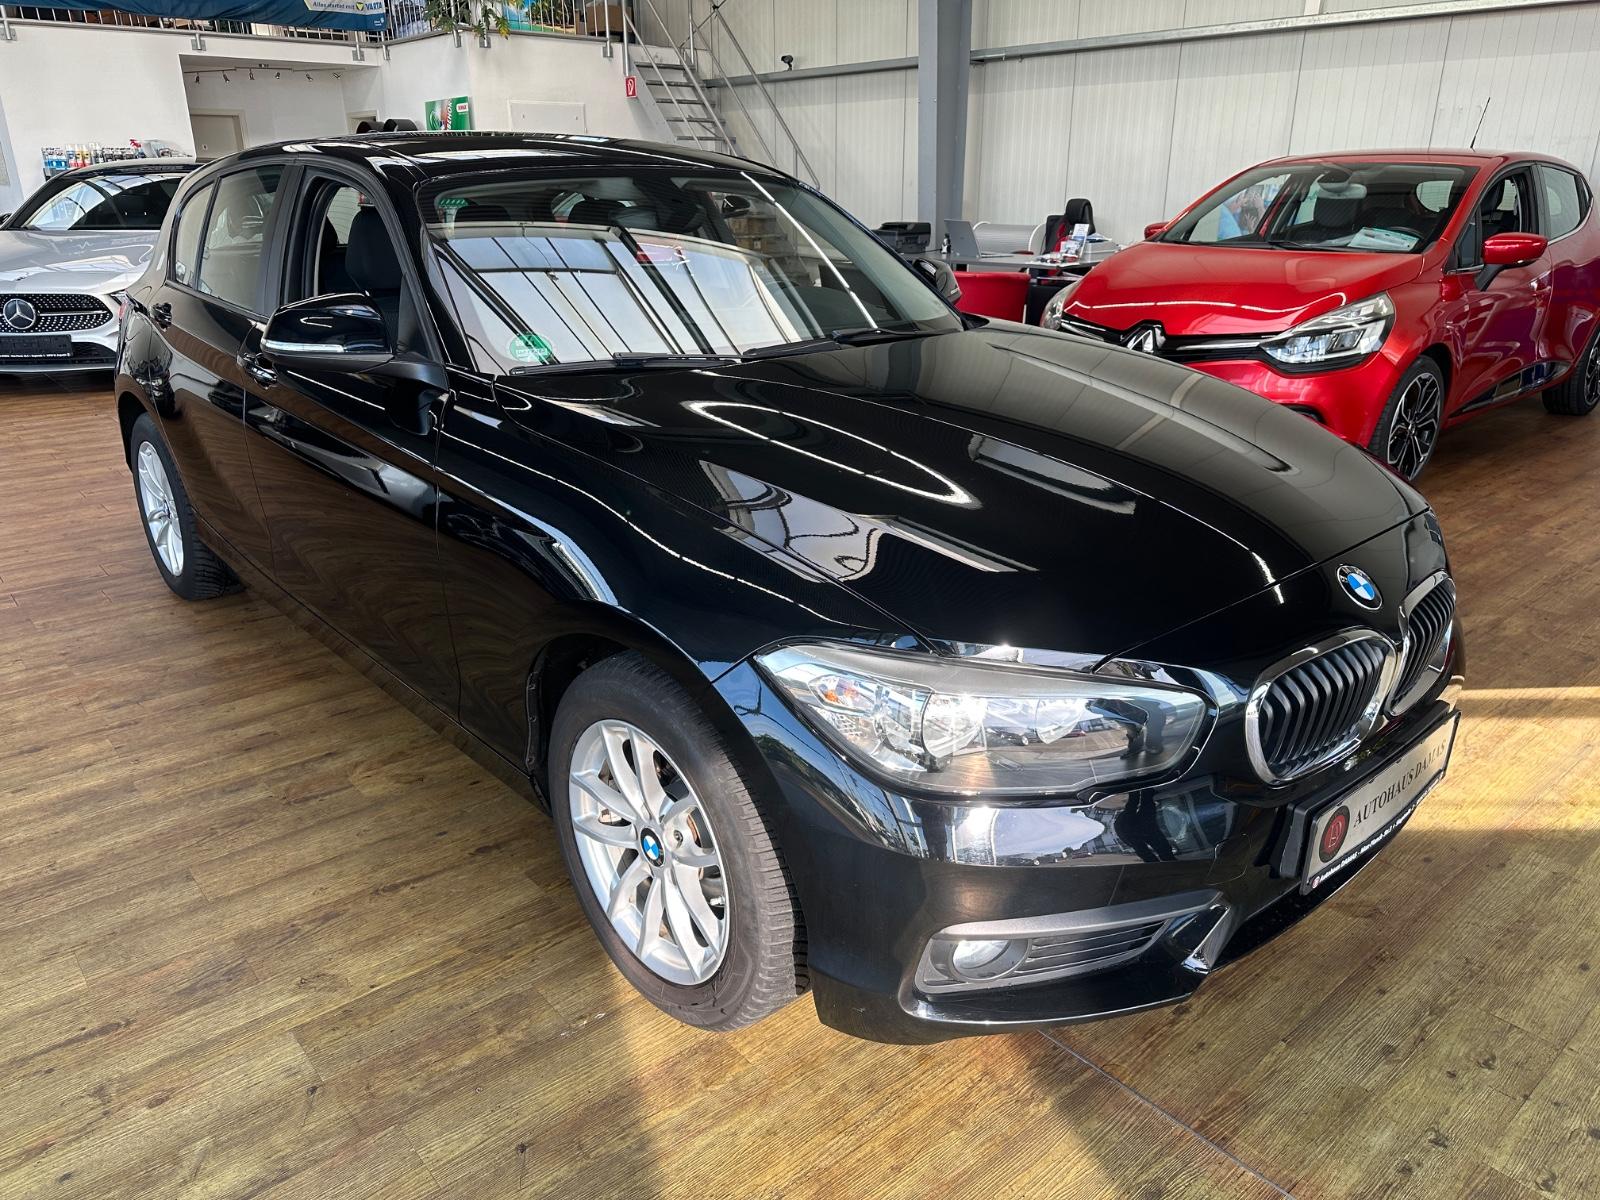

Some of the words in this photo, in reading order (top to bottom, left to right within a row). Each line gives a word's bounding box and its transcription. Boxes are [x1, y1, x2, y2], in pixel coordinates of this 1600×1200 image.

[365, 2, 383, 11] VARTA
[1354, 768, 1415, 828] AUTOHAUS
[1414, 739, 1447, 780] DAMAS
